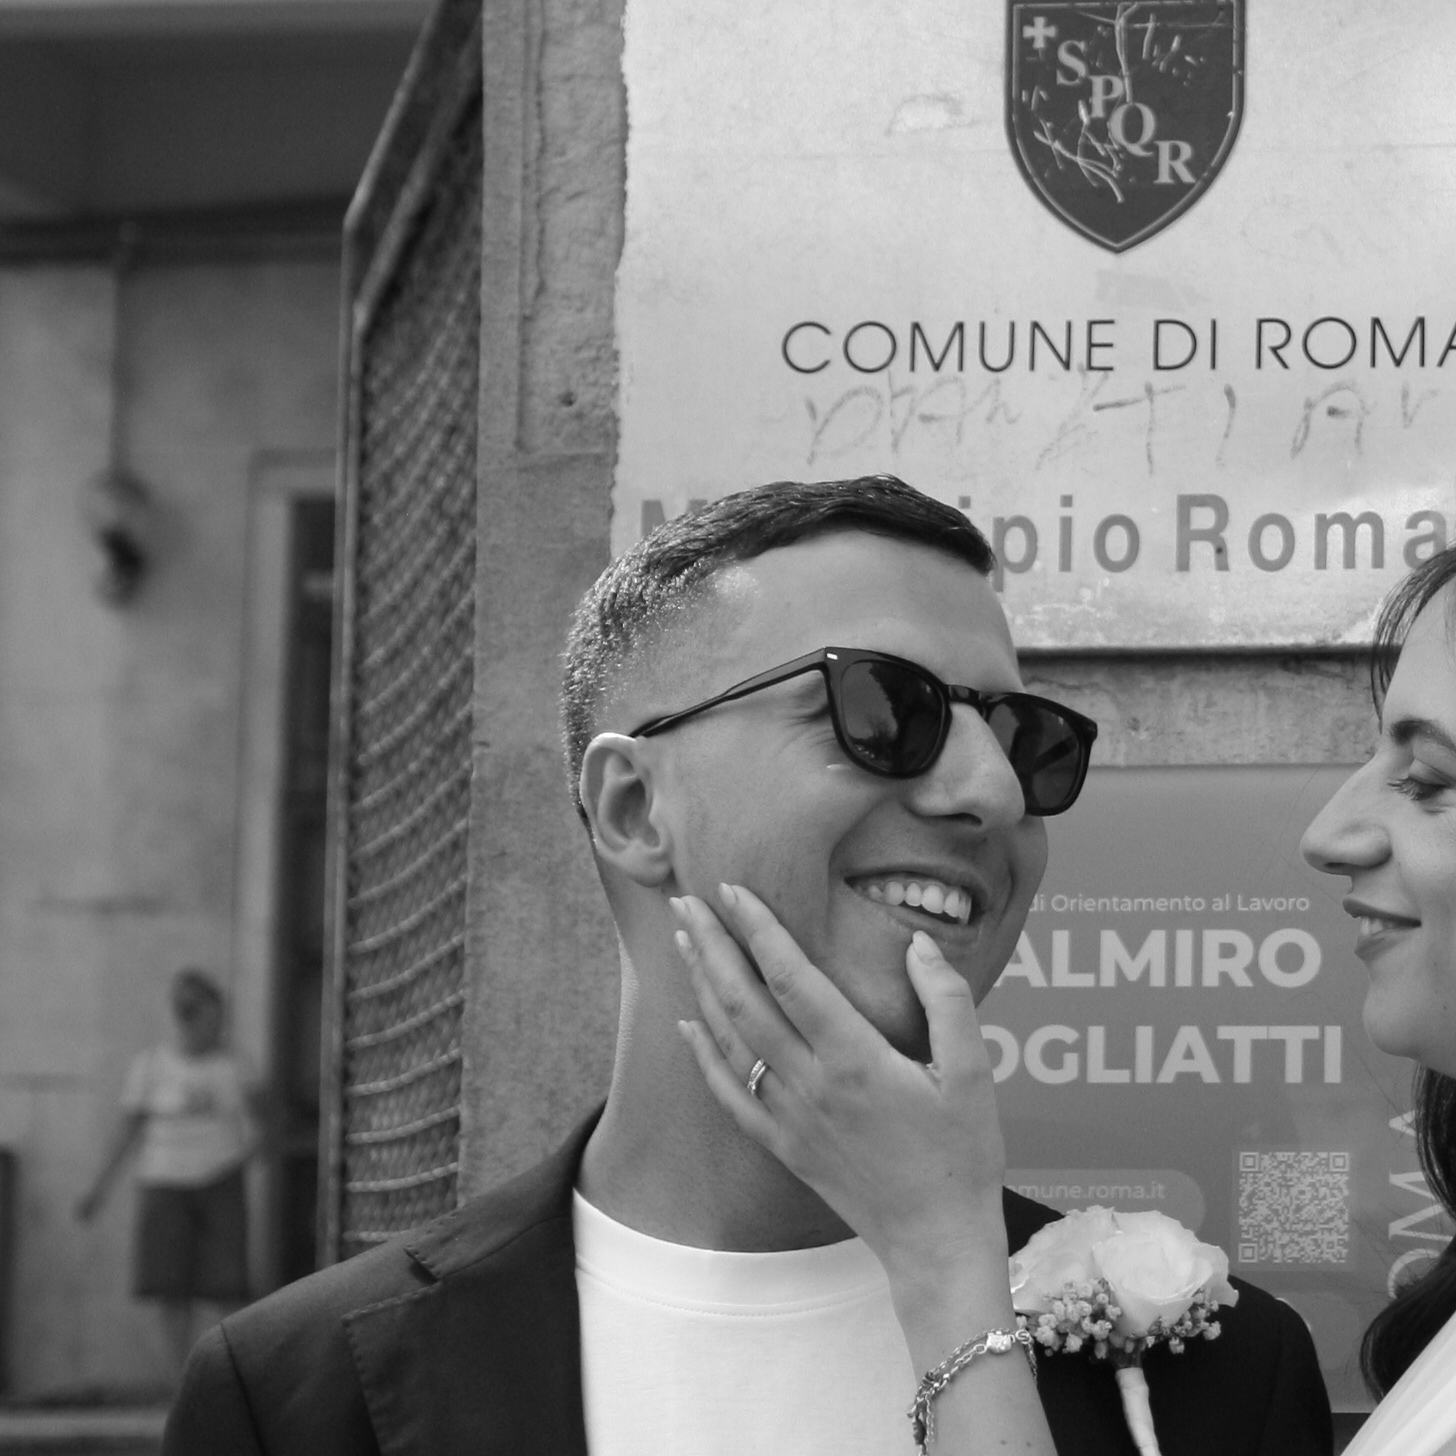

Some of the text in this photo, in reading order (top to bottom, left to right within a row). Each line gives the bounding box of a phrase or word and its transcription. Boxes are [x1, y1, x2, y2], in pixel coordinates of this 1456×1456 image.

[1055, 39, 1197, 185] SPQR
[780, 319, 1116, 374] COMUNE
[1154, 318, 1222, 371] DI
[1174, 491, 1449, 573] Roma
[1051, 894, 1205, 912] Orientamento
[1211, 894, 1231, 912] al
[1237, 894, 1311, 912] Lavoro
[993, 928, 1323, 988] ALMIRO
[980, 1024, 1342, 1084] OGLIATTI
[1005, 1182, 1166, 1200] mune.roma.it
